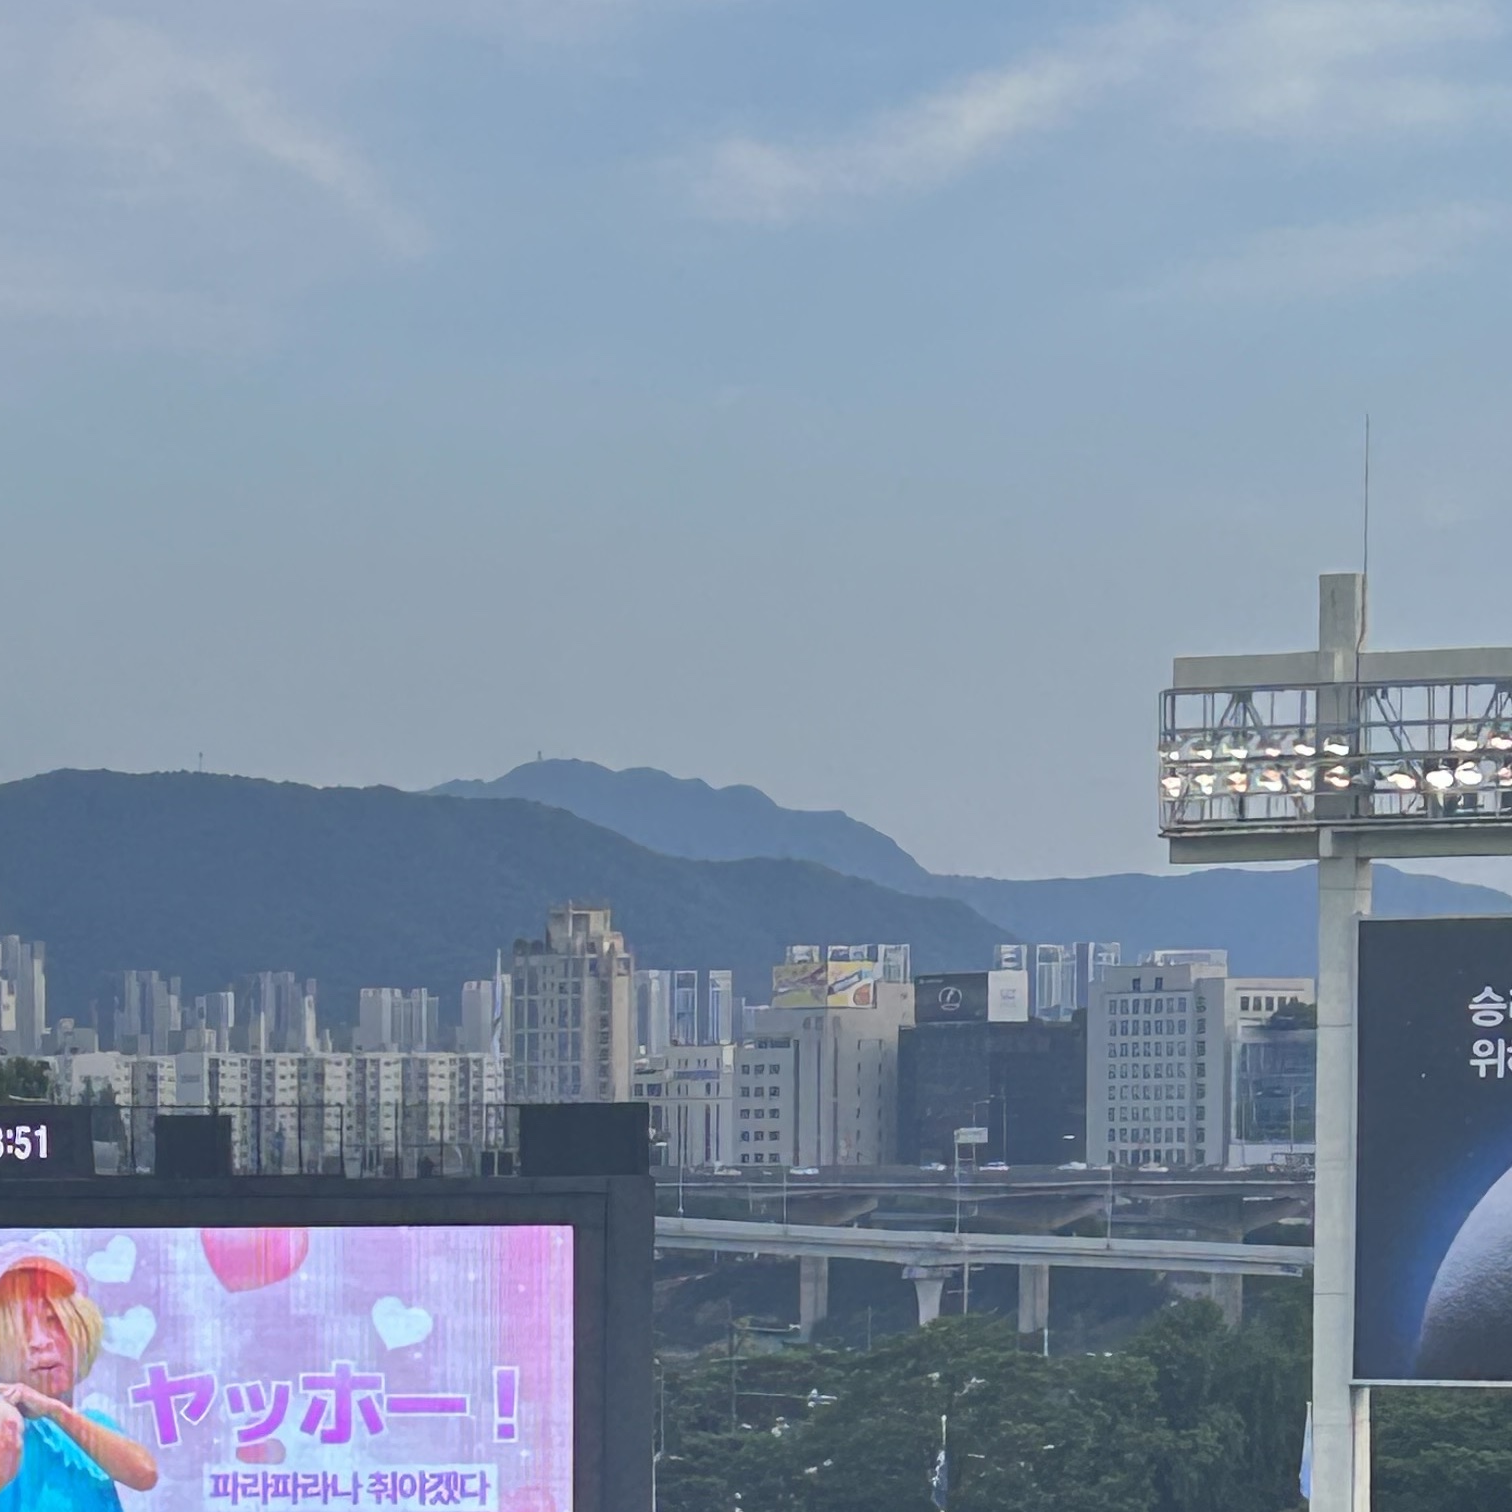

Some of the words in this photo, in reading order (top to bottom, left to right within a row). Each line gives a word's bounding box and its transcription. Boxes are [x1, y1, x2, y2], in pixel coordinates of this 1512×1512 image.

[1468, 986, 1512, 1027] 승
[1469, 1038, 1512, 1079] 위
[208, 1470, 364, 1506] 파라파라나
[366, 1470, 492, 1506] 춰야겠다
